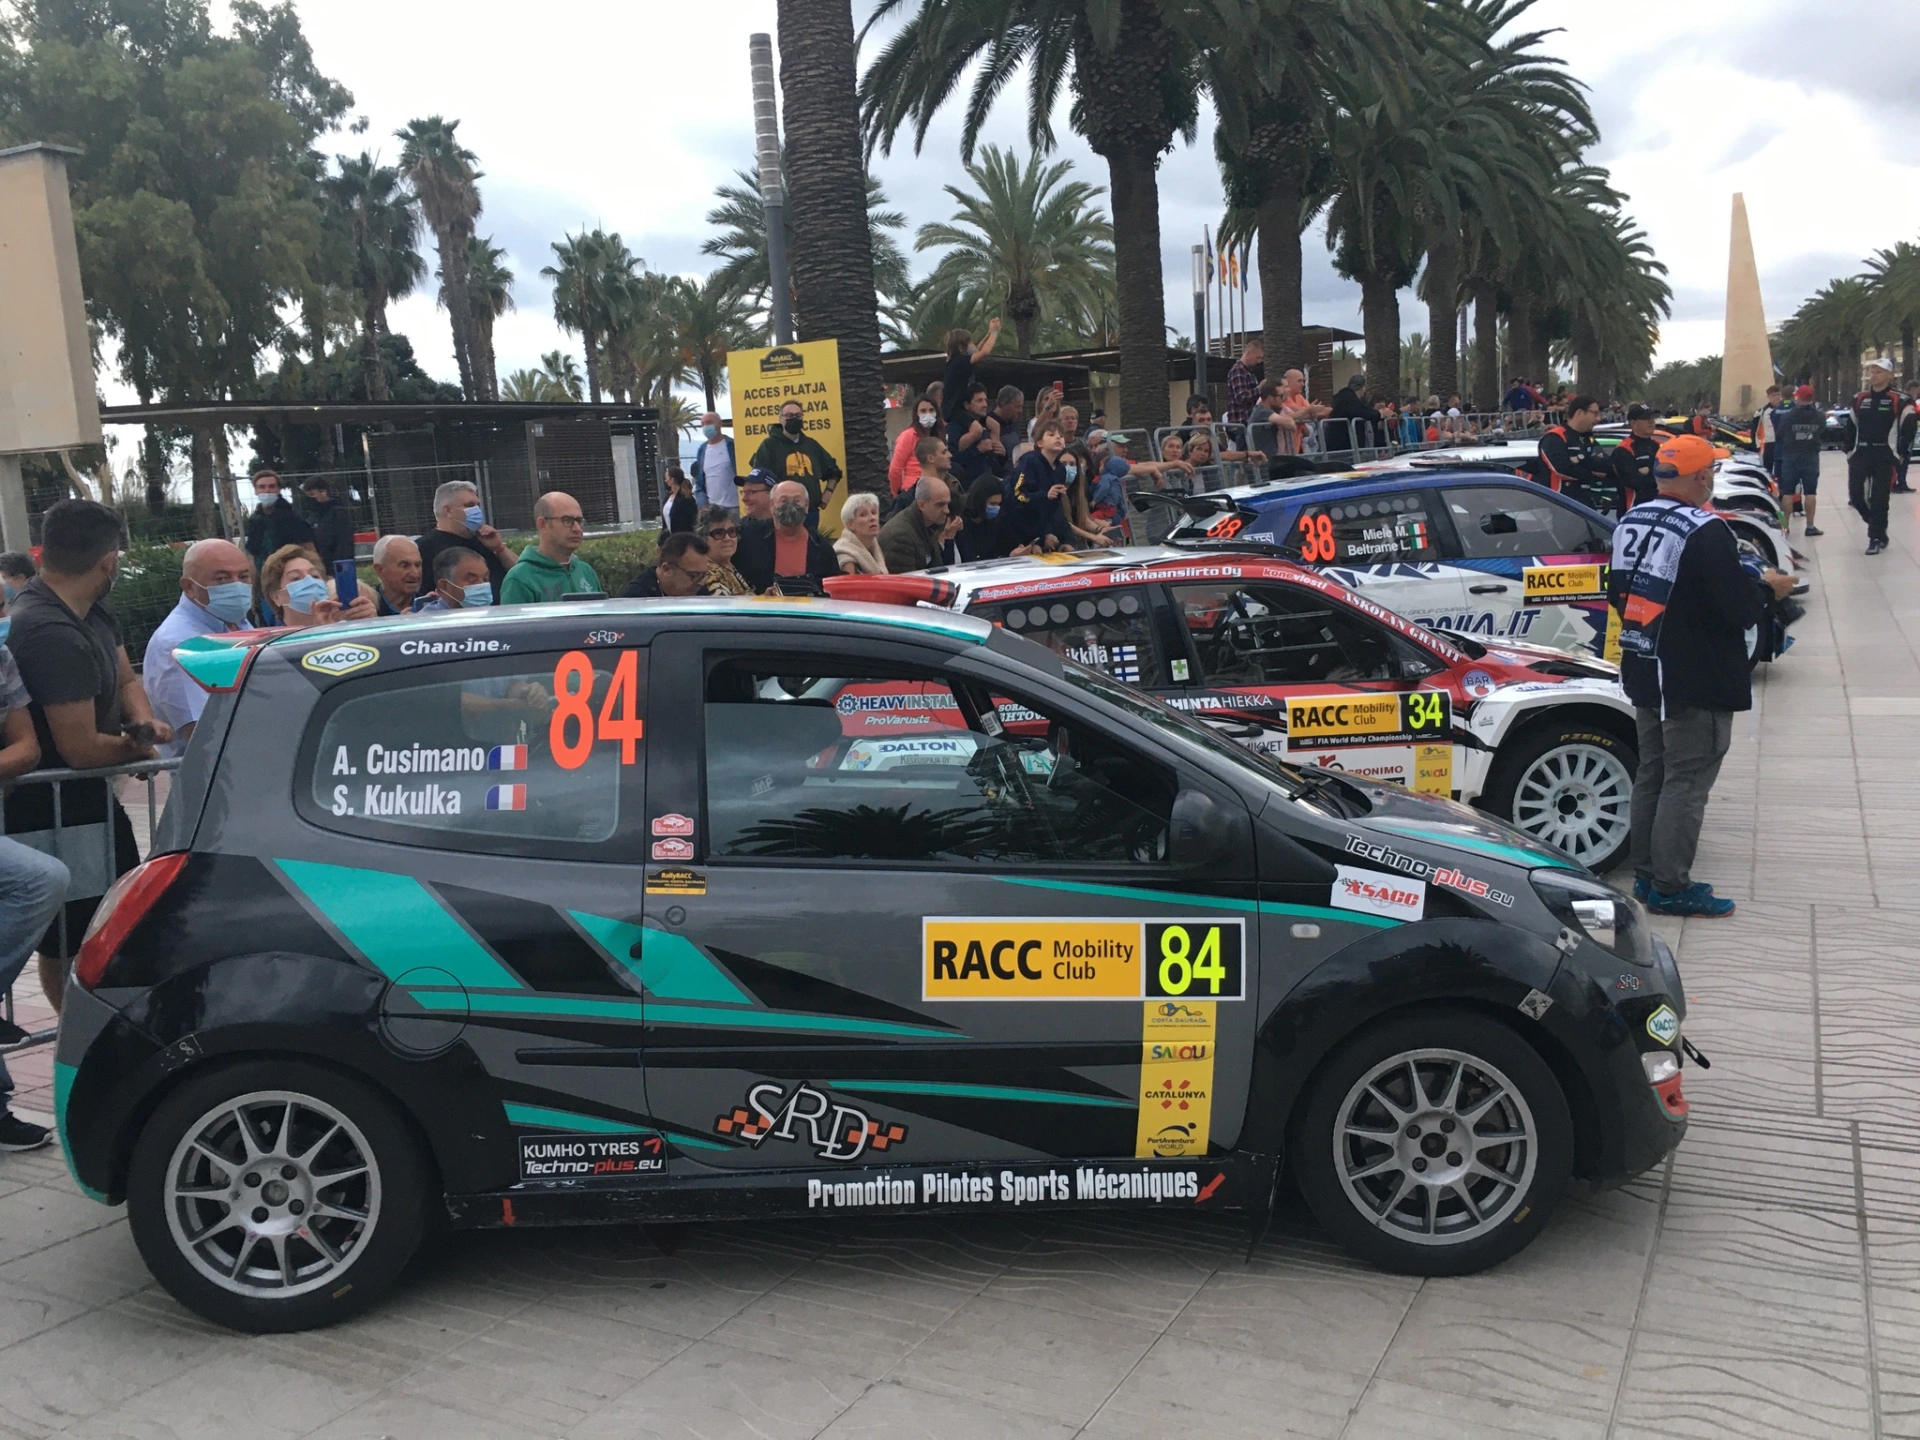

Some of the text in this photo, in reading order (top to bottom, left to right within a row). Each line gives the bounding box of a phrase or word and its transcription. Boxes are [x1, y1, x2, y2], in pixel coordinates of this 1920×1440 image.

[744, 381, 827, 400] ACCES PLATJA
[744, 400, 829, 418] ACCES LAYA
[745, 418, 831, 435] BEAC CESS
[1206, 517, 1242, 538] 38
[1362, 525, 1409, 541] Miele M.
[1299, 514, 1336, 562] 38
[1347, 539, 1412, 556] Beltrame L.
[1109, 566, 1242, 583] HK-Maansiirto Oy
[1526, 573, 1565, 589] RACC
[1567, 571, 1597, 580] Mobility
[1341, 592, 1463, 663] ASKOLAN GRANIT
[588, 629, 618, 644] SRD
[312, 651, 369, 665] YACCO
[1065, 646, 1109, 665] ikkilä
[1466, 676, 1490, 685] BAR
[549, 650, 643, 770] 84
[859, 694, 960, 710] HEAVYINSTAL
[1164, 694, 1273, 710] HINTAHIEKKA
[1353, 702, 1396, 716] Mobility
[1292, 705, 1349, 728] RACC
[1408, 692, 1443, 730] 34
[1353, 714, 1377, 726] Club
[882, 741, 957, 753] DALTON
[1317, 737, 1329, 745] FIA
[1330, 736, 1349, 744] World
[1350, 735, 1367, 745] Rally
[1367, 733, 1413, 743] Championship
[332, 742, 485, 775] A. Cusimano
[331, 784, 461, 816] S. Kukulka
[1344, 832, 1515, 908] Techno-plus.eu
[932, 940, 1042, 980] RACC
[1053, 940, 1134, 964] Mobility
[1158, 925, 1226, 995] 84
[1053, 961, 1096, 980] Club
[1151, 1044, 1207, 1061] SALOU
[1145, 1090, 1206, 1099] CATALUNYA
[741, 1082, 869, 1161] SRD
[1147, 1136, 1196, 1144] PortAventura
[524, 1141, 640, 1159] KUMHO TYRES
[524, 1158, 663, 1175] Techno-plus.eu
[807, 1165, 1199, 1208] Promotion Pilotes Sports Mécaniques
